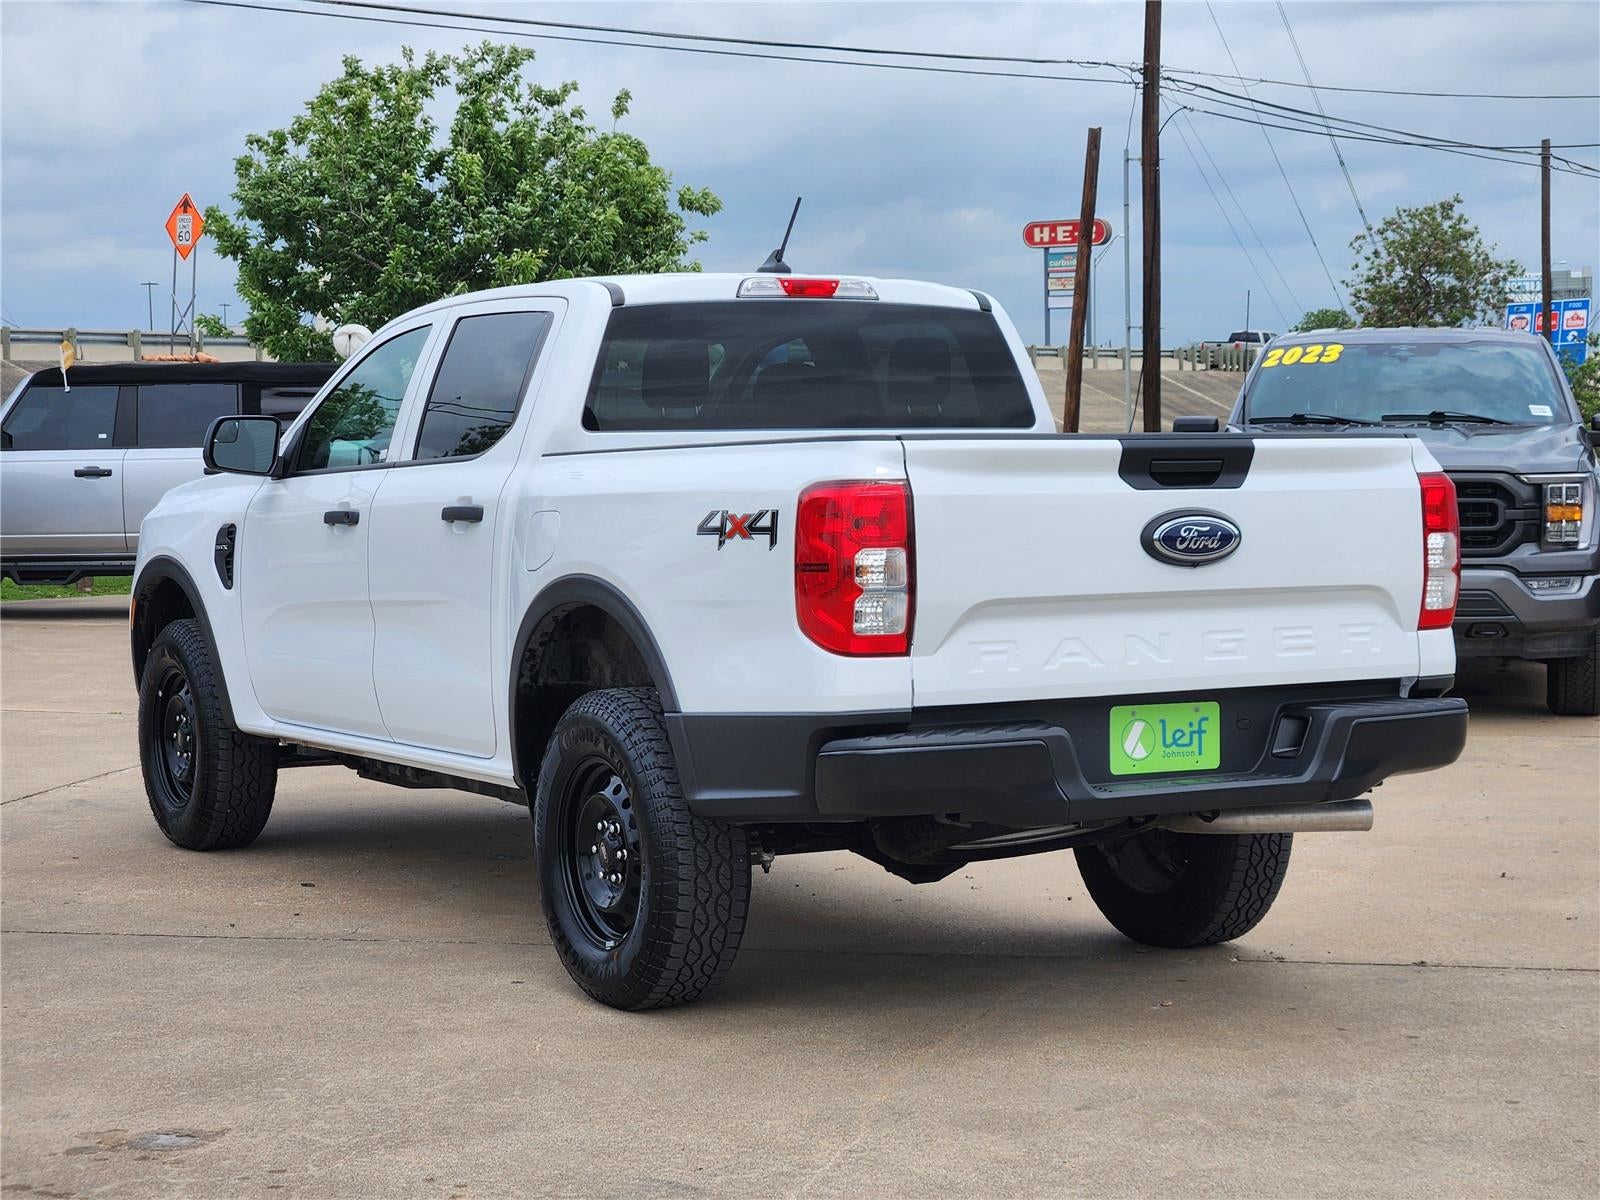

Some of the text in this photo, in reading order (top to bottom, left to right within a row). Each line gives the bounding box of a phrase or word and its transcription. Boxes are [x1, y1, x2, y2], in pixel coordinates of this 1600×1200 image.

[178, 230, 191, 242] 60
[1049, 259, 1077, 267] curbsid
[1261, 344, 1344, 368] 2023
[1176, 525, 1221, 549] Ford
[968, 622, 1381, 674] RANGER
[1161, 750, 1195, 758] Johnson
